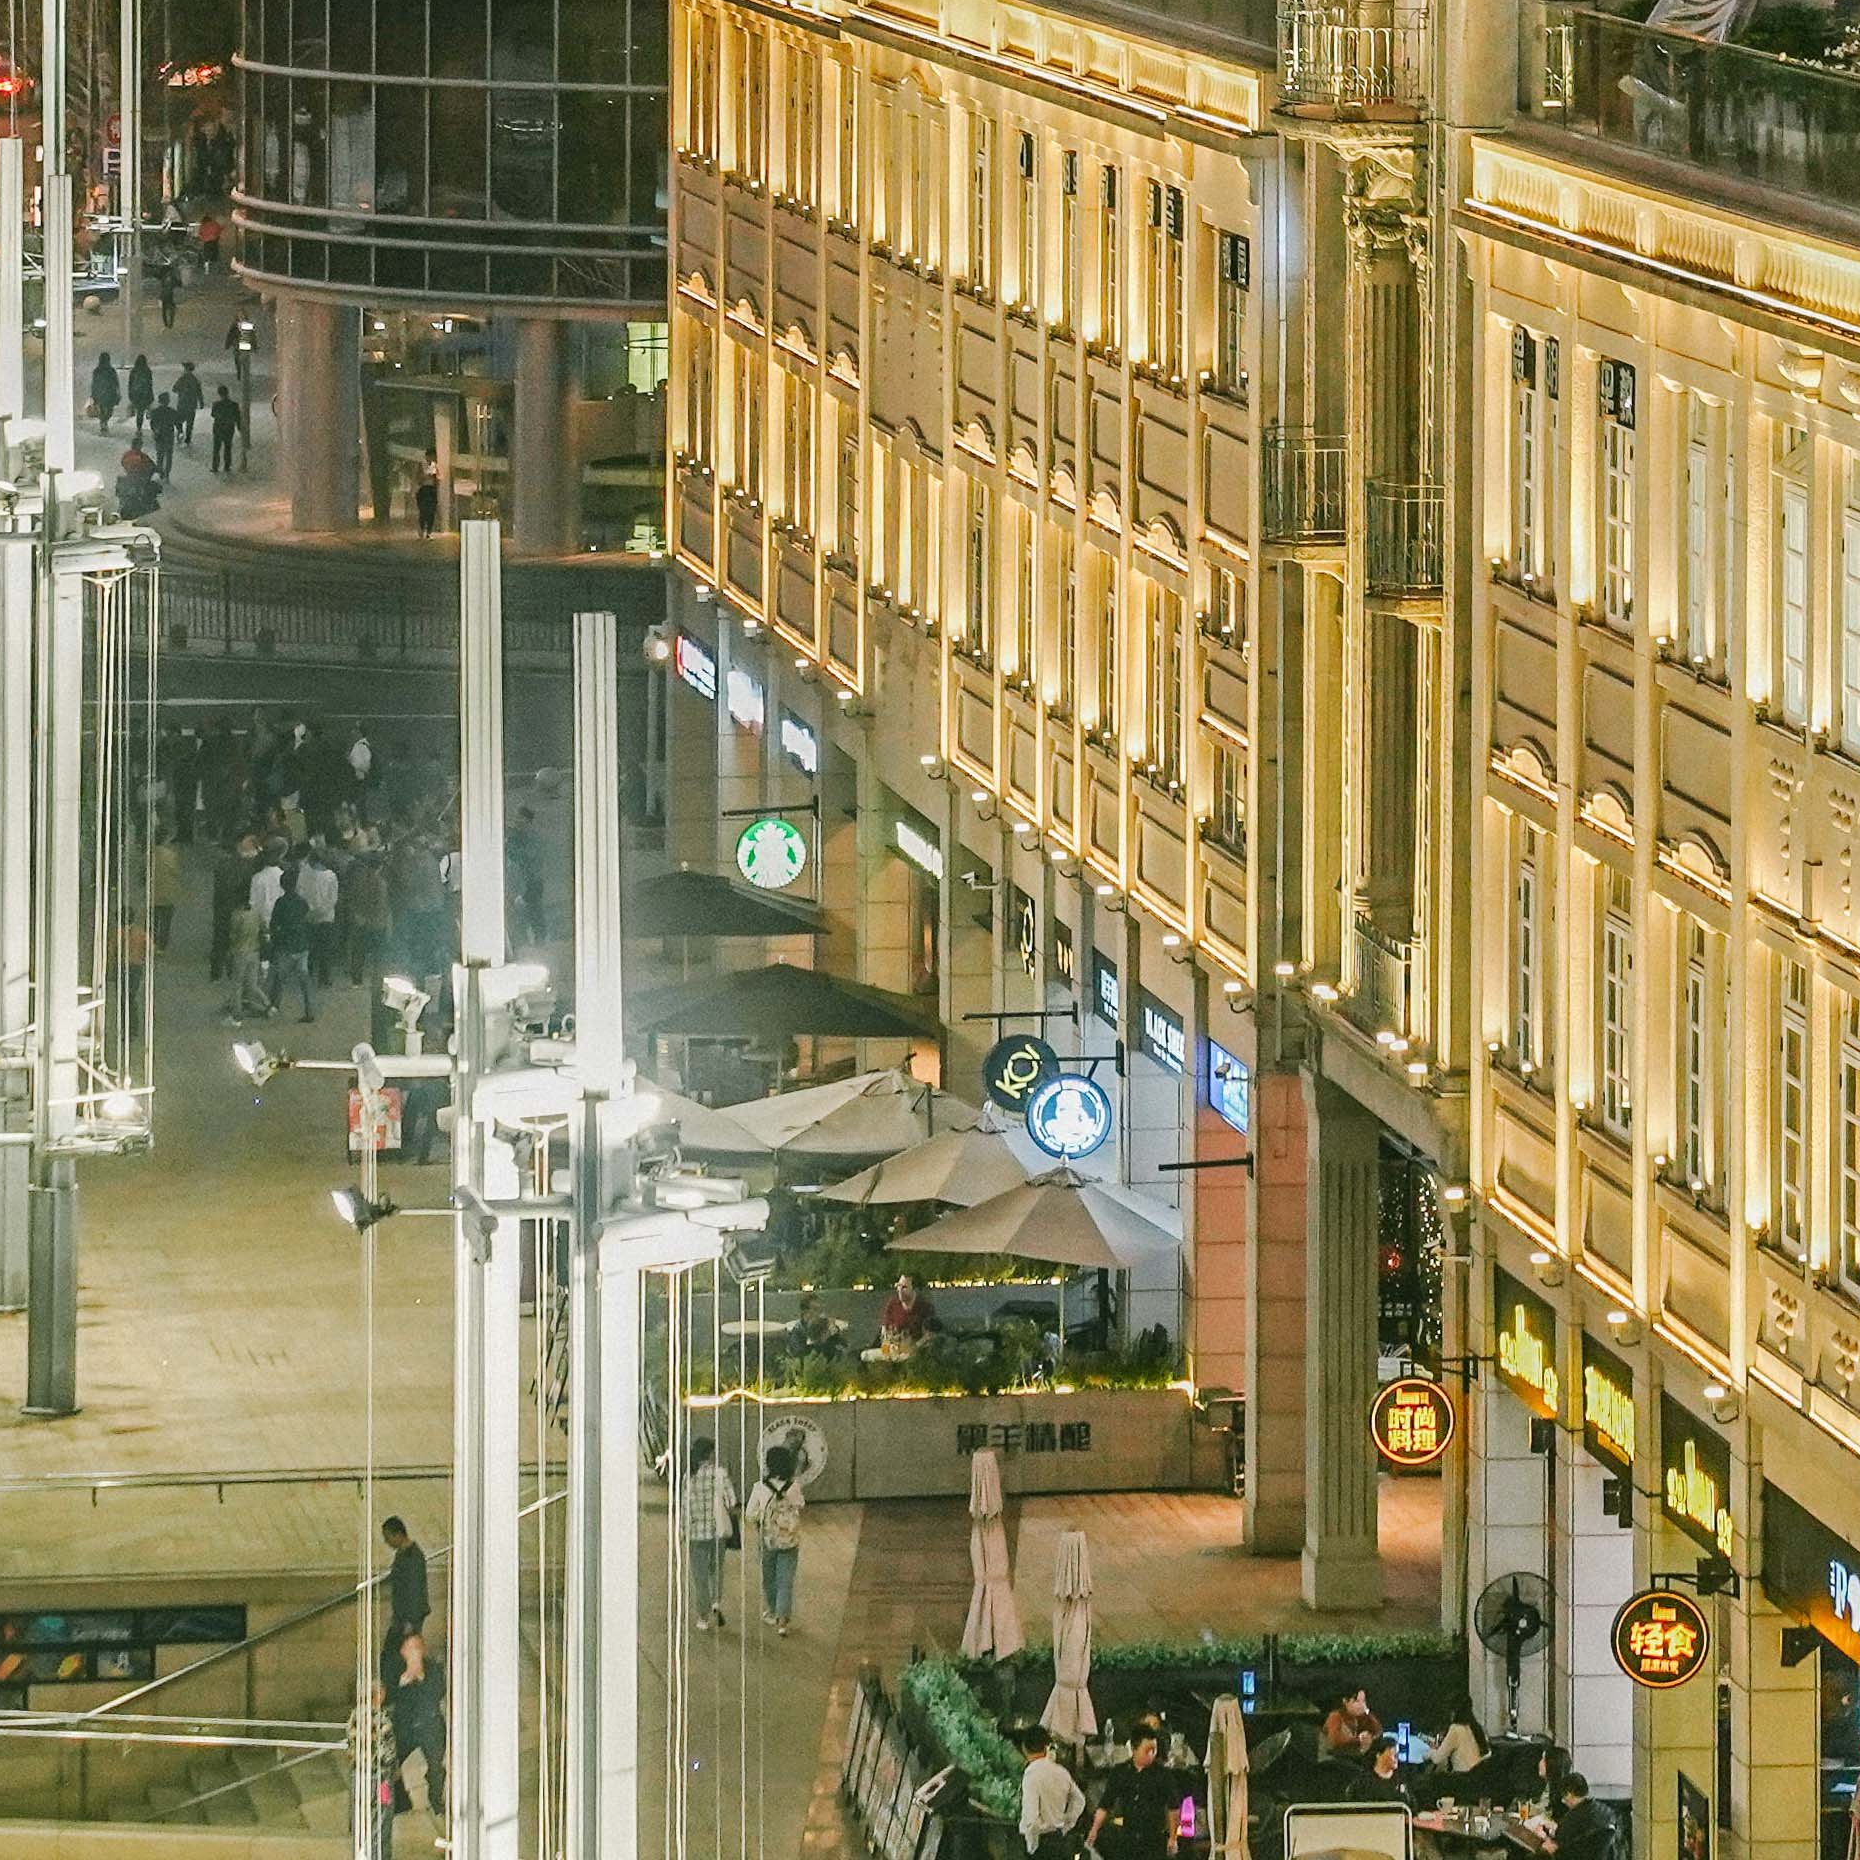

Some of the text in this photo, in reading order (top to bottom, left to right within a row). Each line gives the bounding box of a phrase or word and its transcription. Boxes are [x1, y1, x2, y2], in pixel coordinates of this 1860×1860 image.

[1386, 1405, 1437, 1430] 时尚
[956, 1421, 1092, 1455] 黑羊精酿
[1386, 1428, 1438, 1452] 料理
[1629, 1621, 1697, 1658] 轻食
